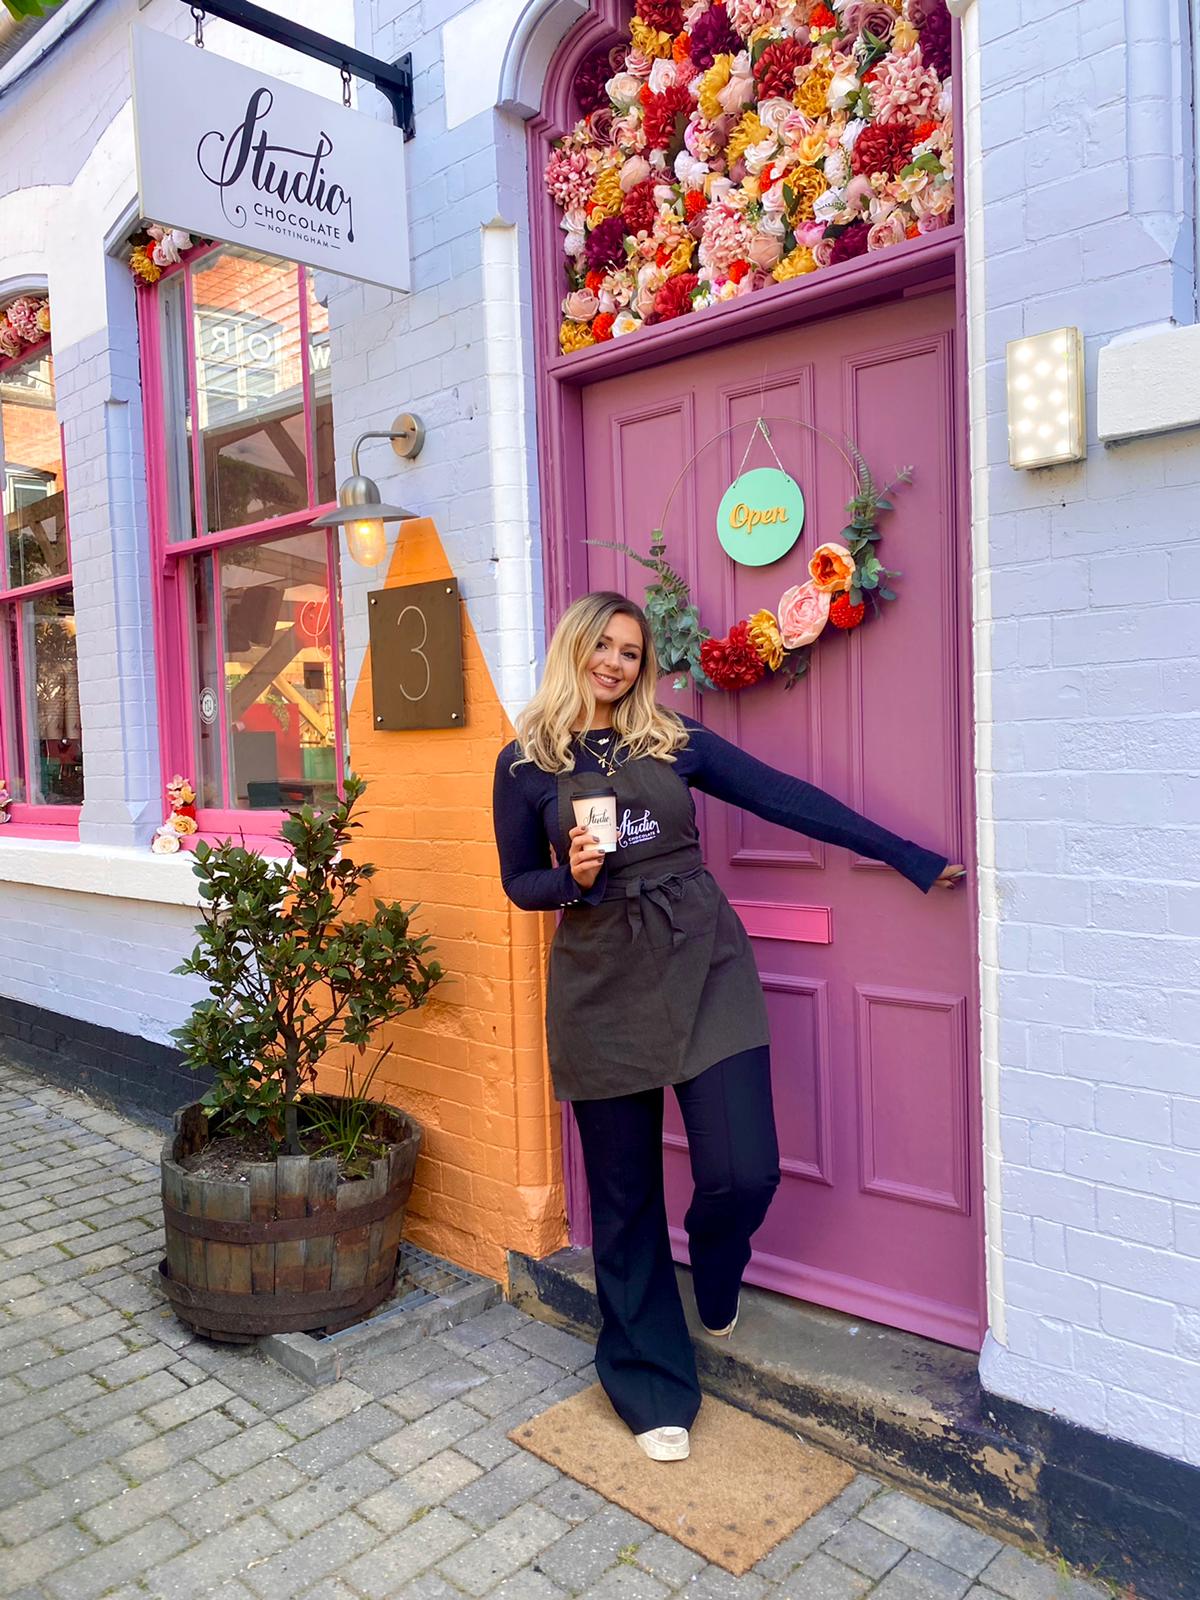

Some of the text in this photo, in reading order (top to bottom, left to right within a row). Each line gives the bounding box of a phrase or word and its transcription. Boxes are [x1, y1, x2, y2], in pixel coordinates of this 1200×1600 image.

[197, 87, 354, 243] Studio
[253, 202, 341, 240] CHOCOLATE
[267, 223, 329, 248] NOTTINGHAM
[729, 502, 790, 535] Open
[397, 605, 430, 701] 3
[616, 808, 660, 848] Studio
